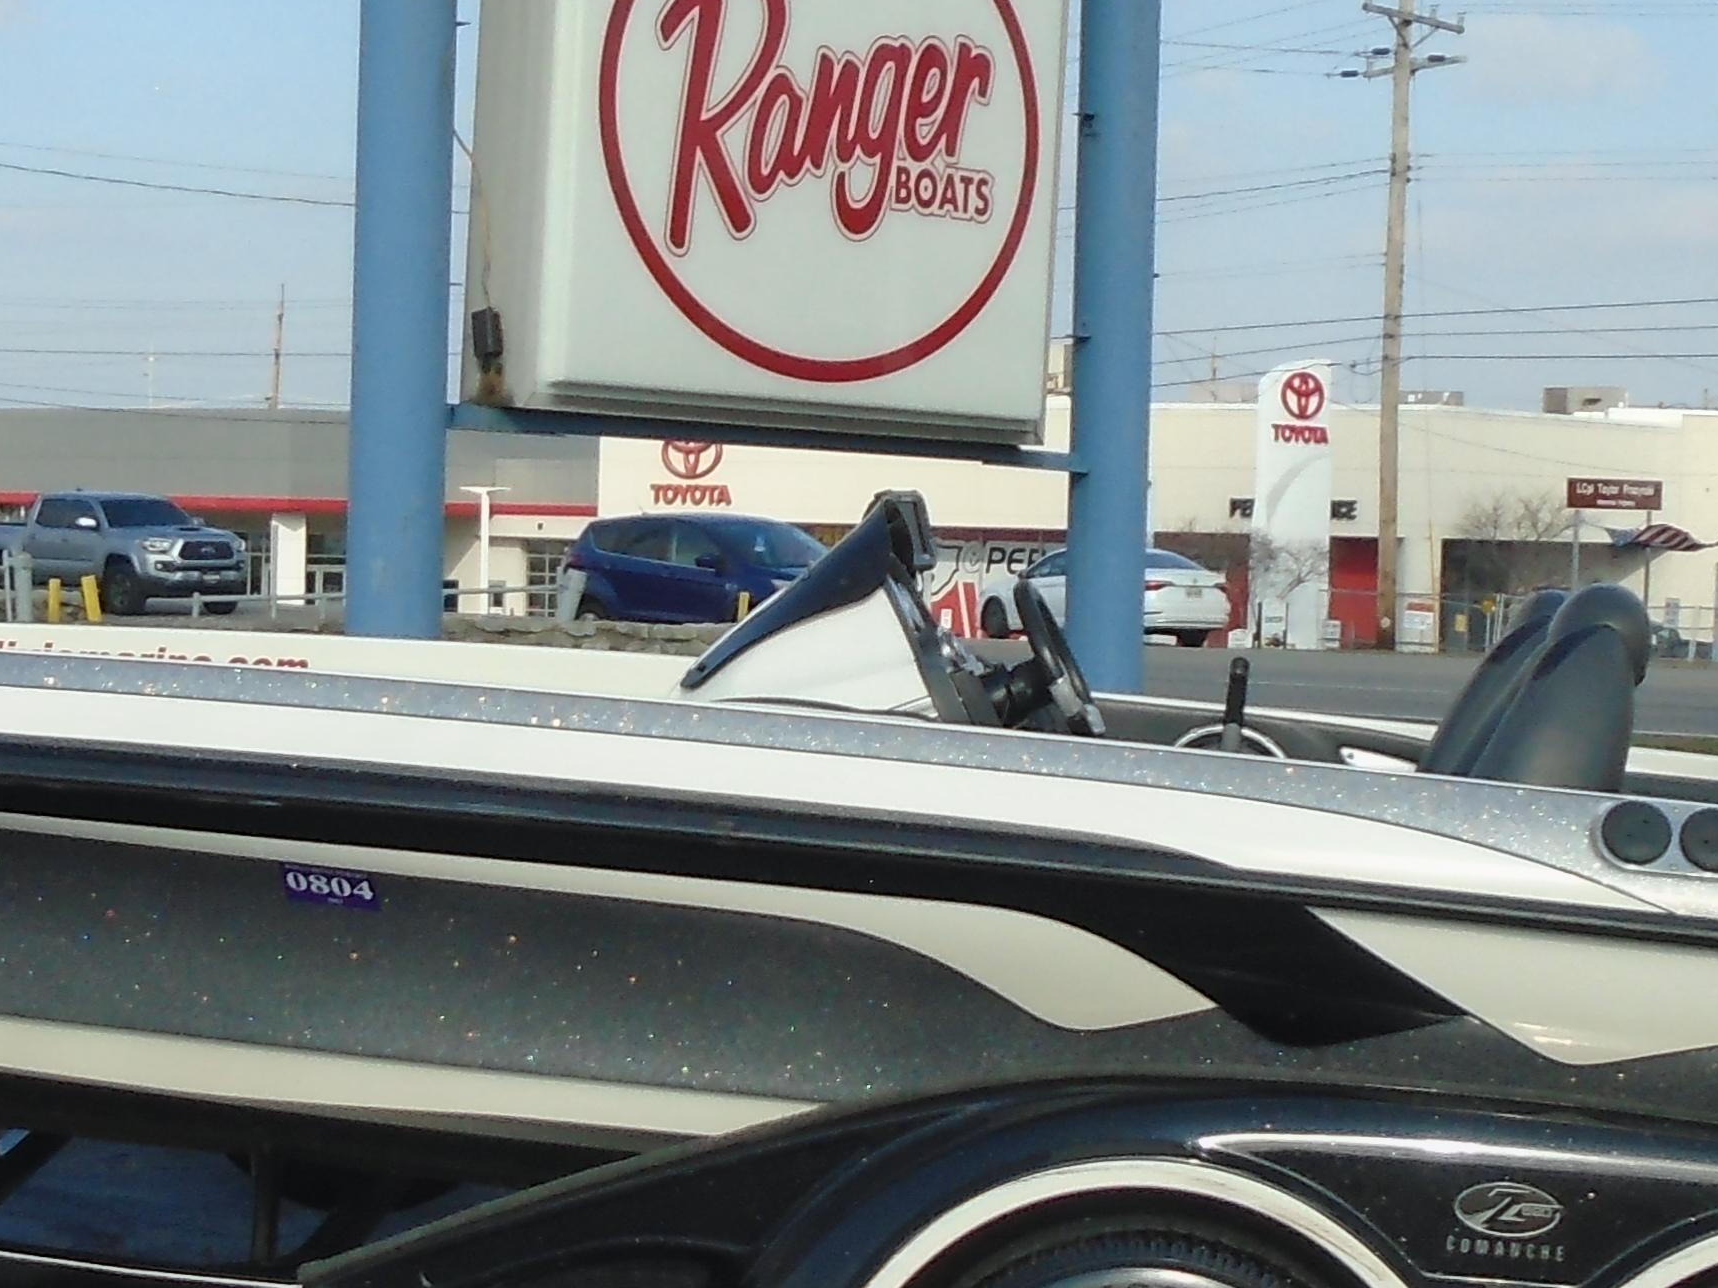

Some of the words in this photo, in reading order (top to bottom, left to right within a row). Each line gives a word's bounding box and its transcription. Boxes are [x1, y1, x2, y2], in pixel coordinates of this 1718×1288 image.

[895, 163, 991, 219] BOATS
[1271, 423, 1330, 445] TOYOTA
[649, 483, 733, 507] TOYOTA
[285, 871, 375, 901] 0804
[1445, 1234, 1565, 1263] COMANCHE
